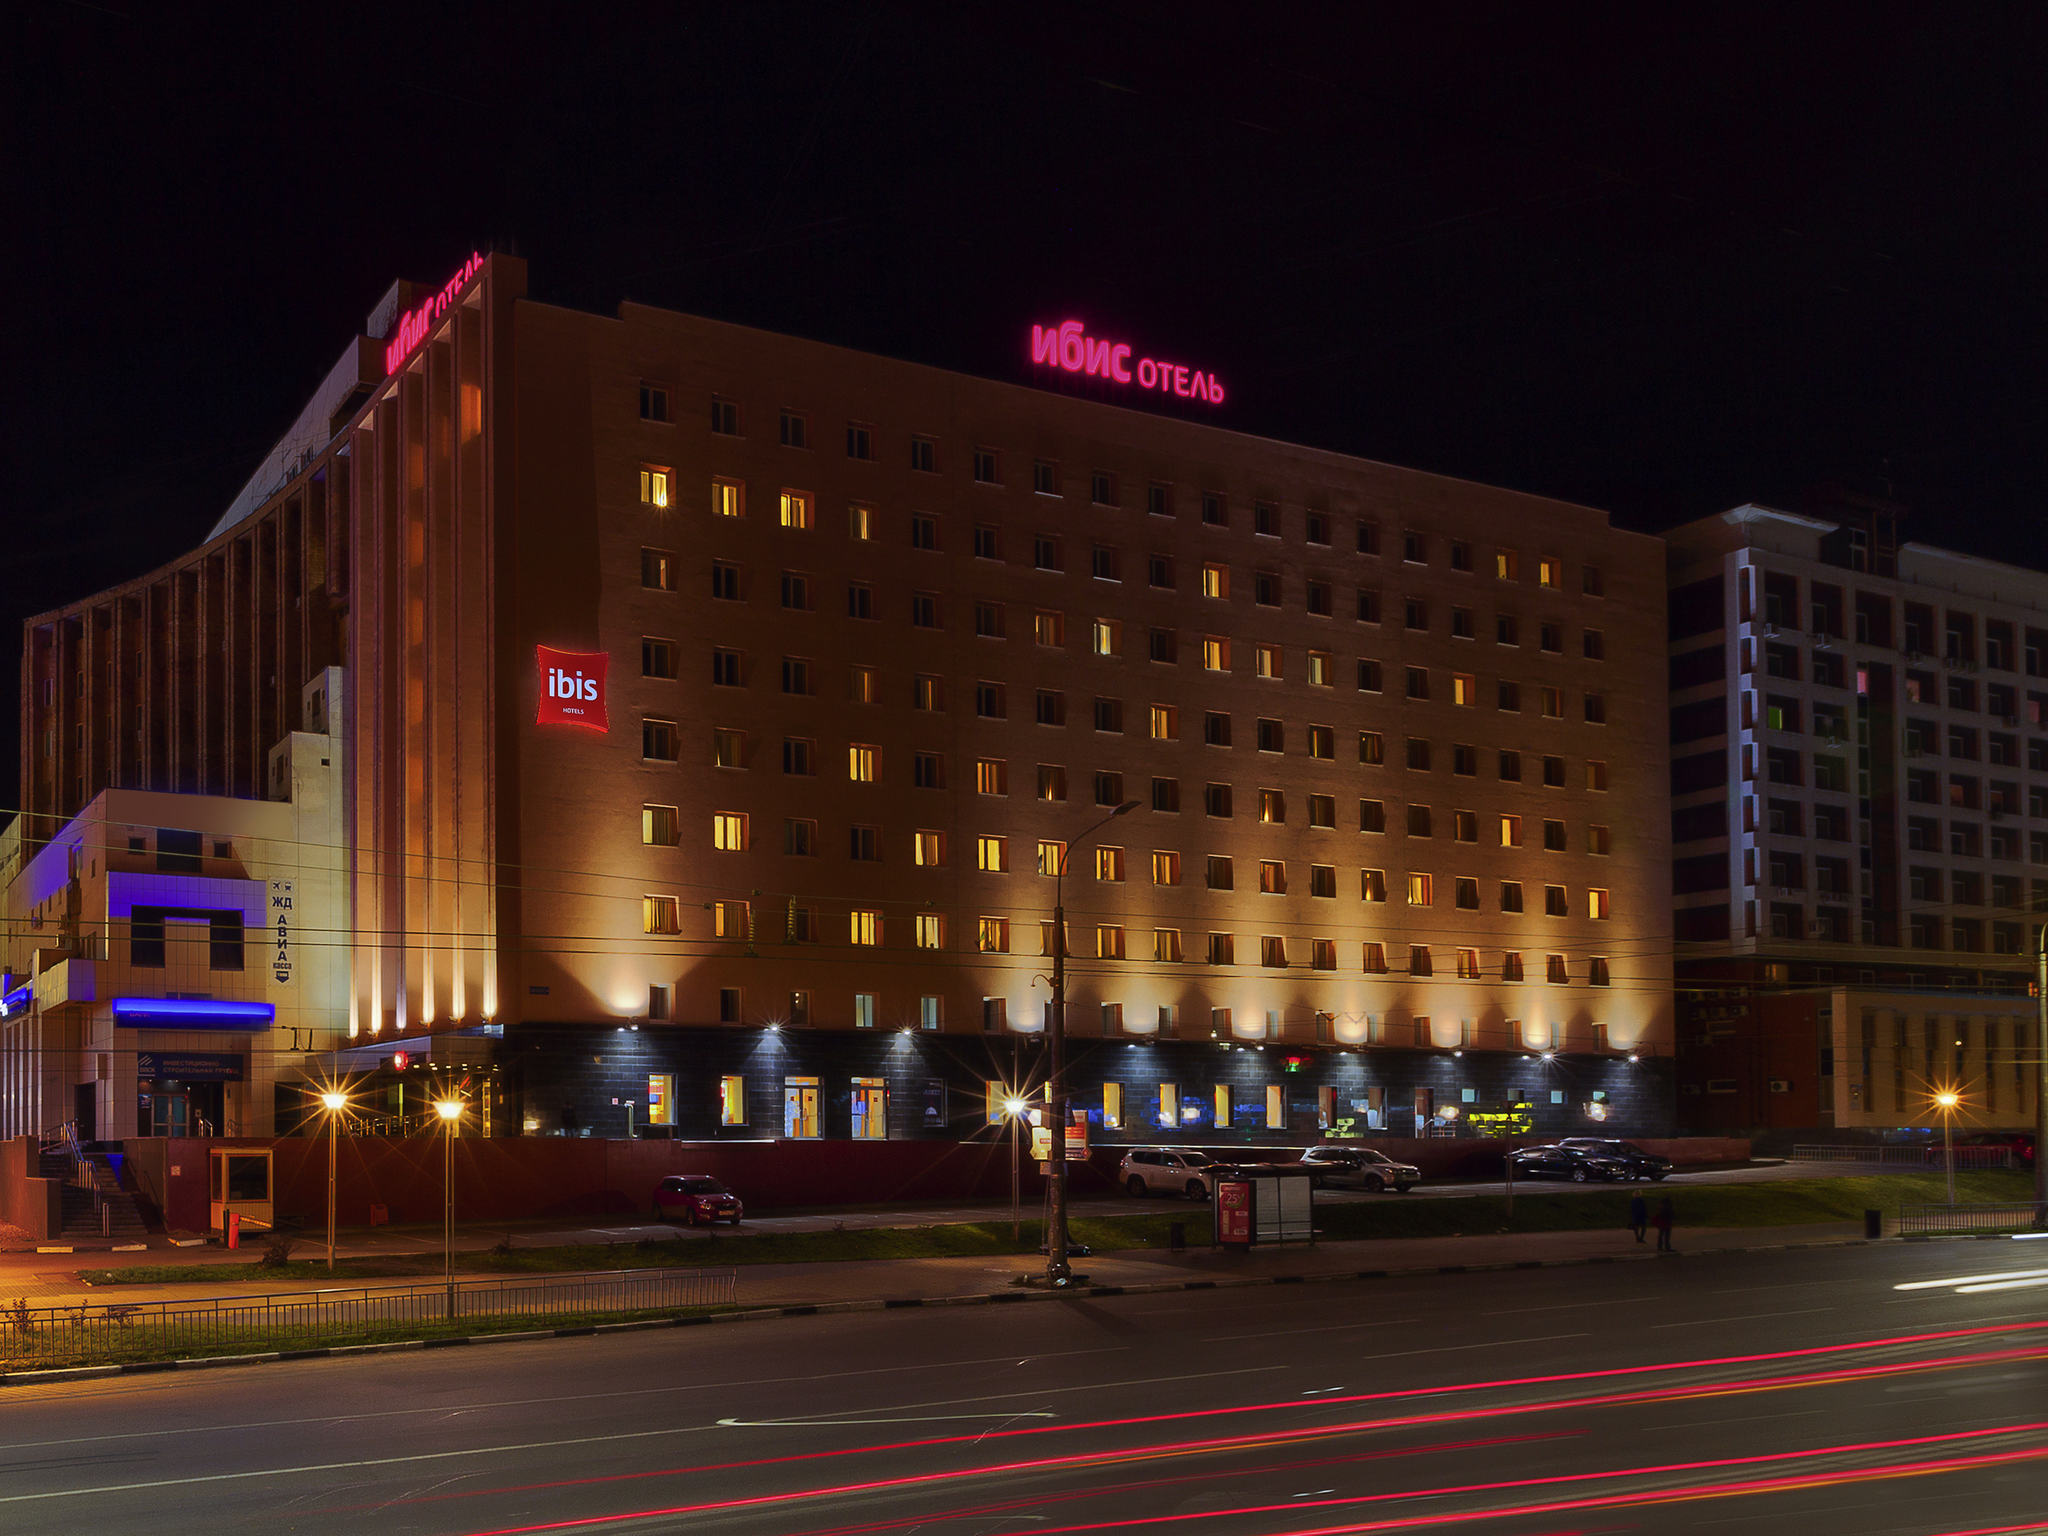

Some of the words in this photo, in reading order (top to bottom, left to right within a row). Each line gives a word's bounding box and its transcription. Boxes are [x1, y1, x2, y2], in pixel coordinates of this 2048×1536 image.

[1137, 357, 1225, 405] ОТЕЛЬ
[548, 667, 599, 701] ibis
[562, 707, 584, 715] HOTELS
[272, 896, 292, 910] ЖД
[277, 914, 287, 961] АВИА
